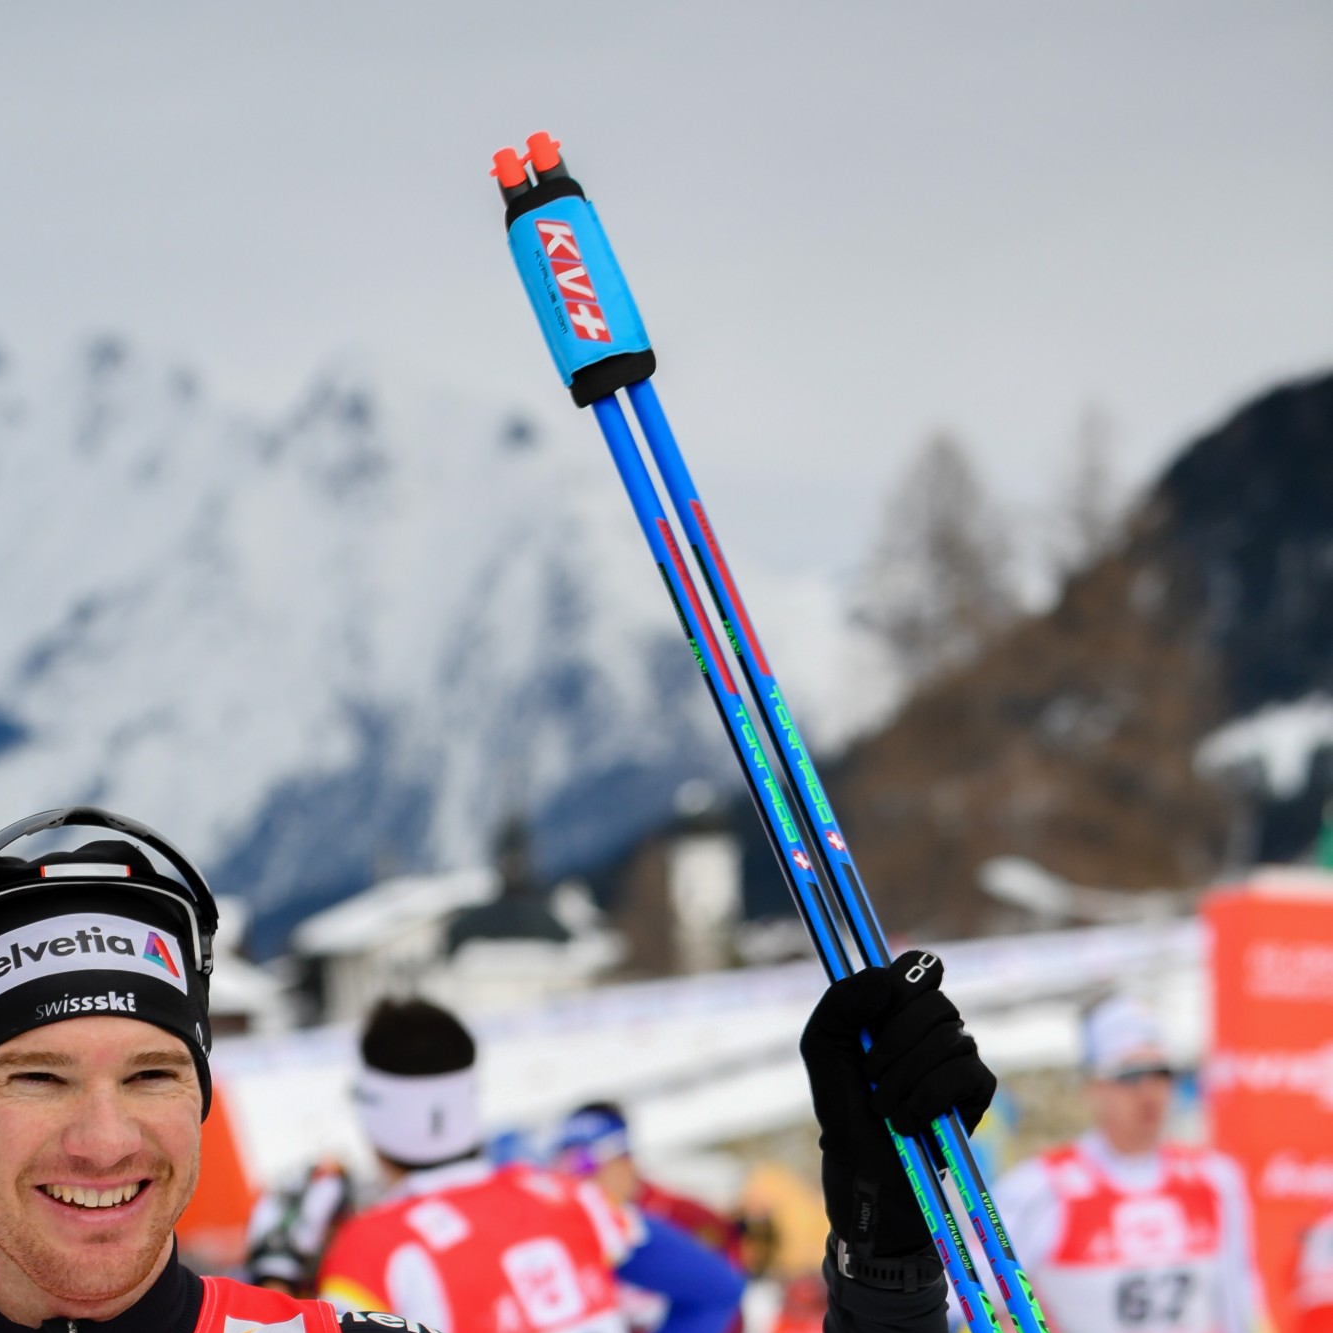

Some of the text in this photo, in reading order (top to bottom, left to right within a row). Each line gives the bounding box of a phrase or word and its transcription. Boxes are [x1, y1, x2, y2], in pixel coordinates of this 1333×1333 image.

[35, 990, 137, 1020] swissski
[944, 1212, 973, 1271] KVPLUS.COM
[980, 1191, 1010, 1249] KVPLUS.COM
